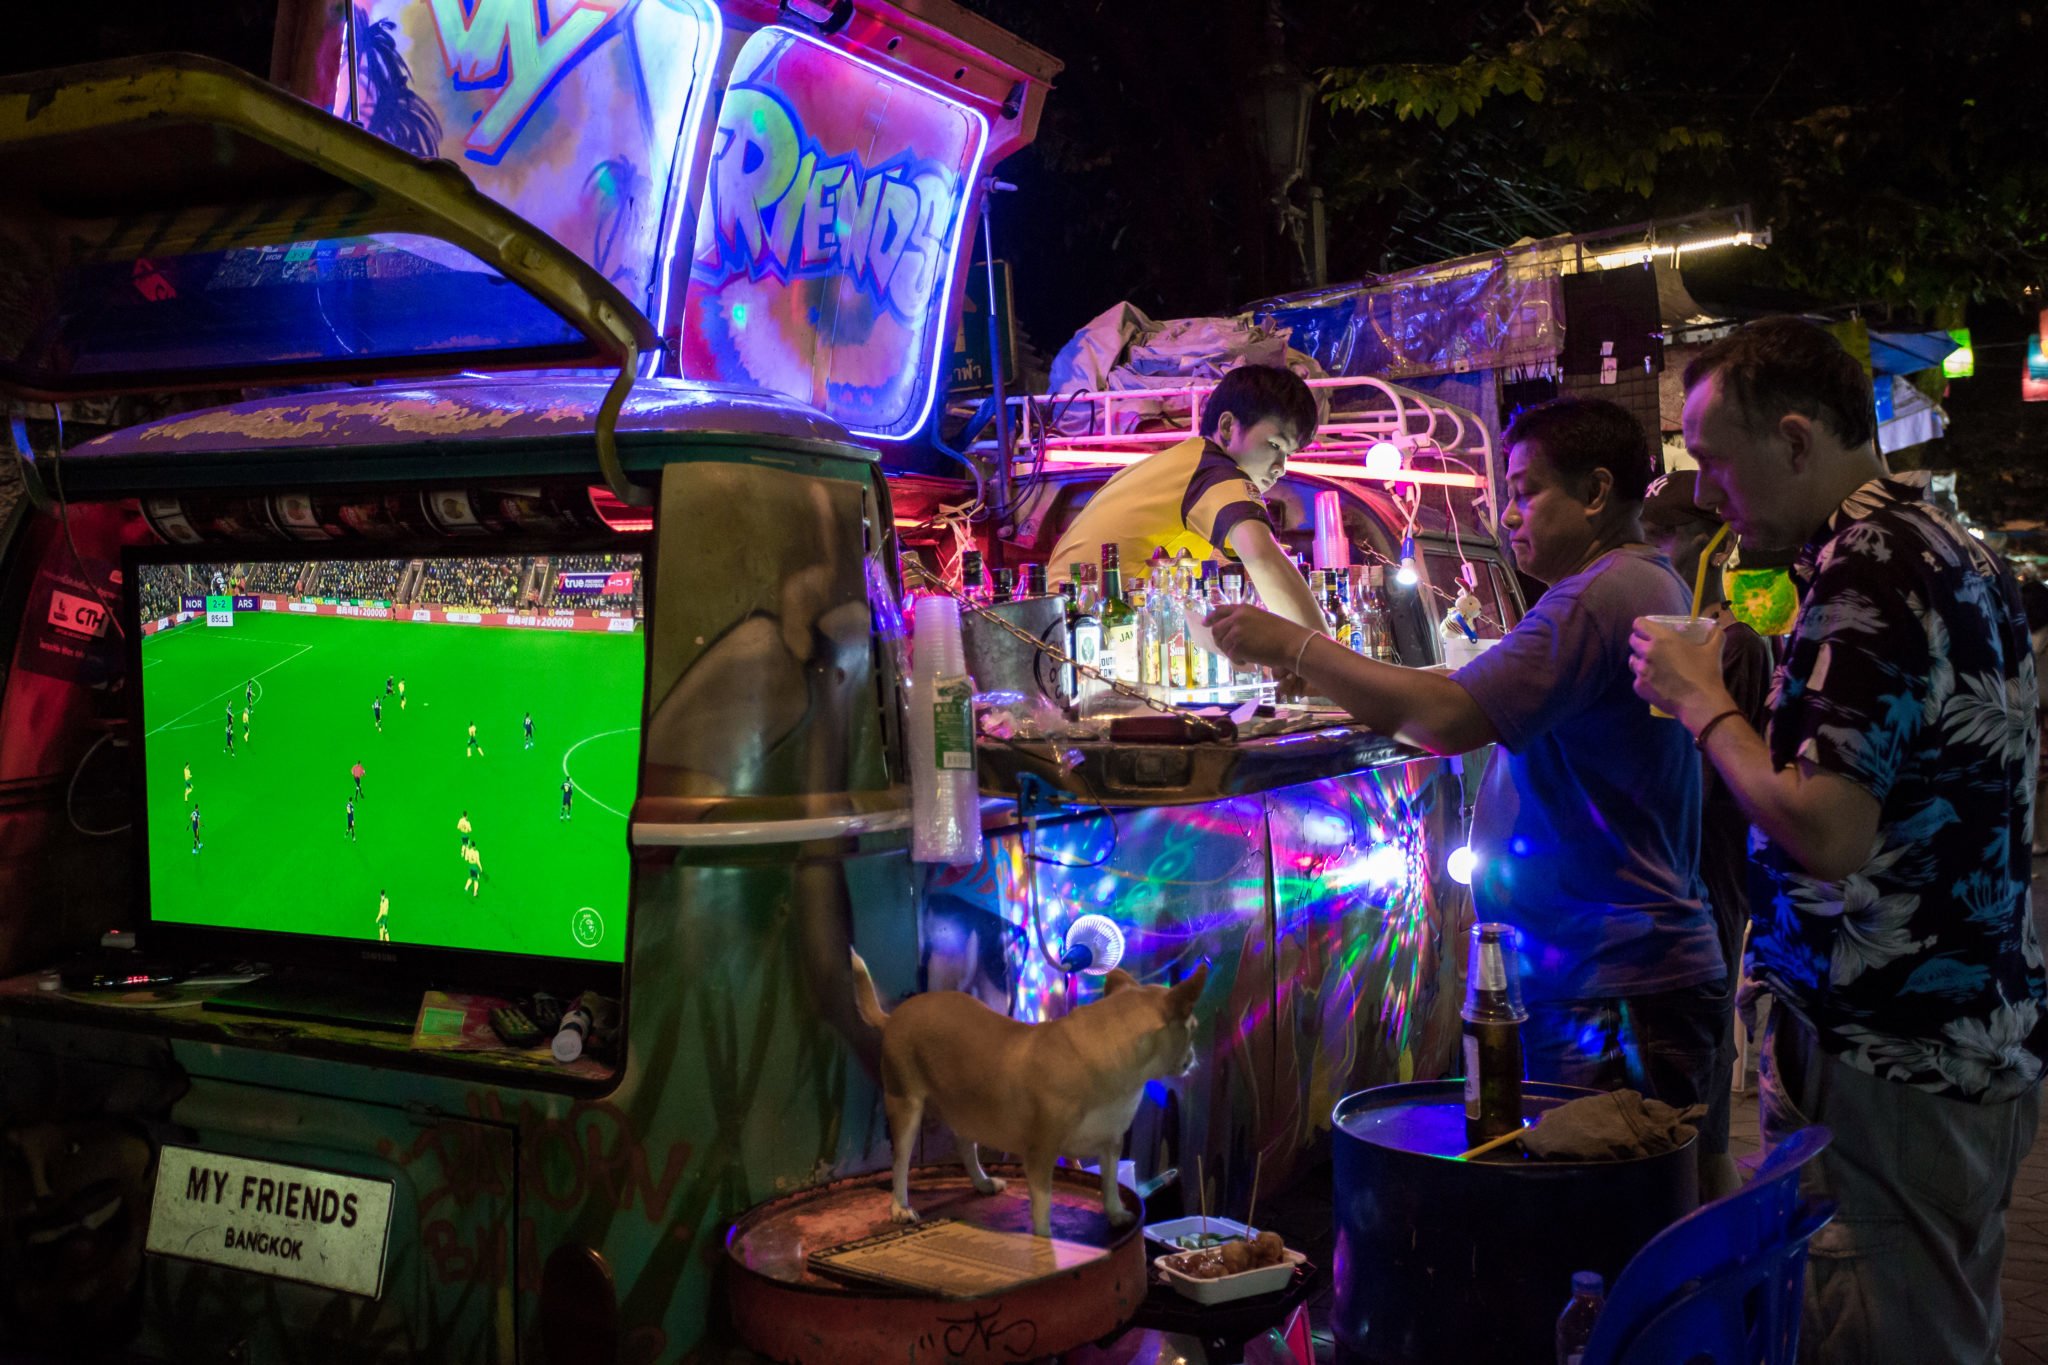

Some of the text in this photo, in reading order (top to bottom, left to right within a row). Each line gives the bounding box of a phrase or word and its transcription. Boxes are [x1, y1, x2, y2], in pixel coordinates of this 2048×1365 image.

[565, 577, 584, 588] true
[185, 599, 203, 609] NOR
[212, 599, 226, 608] 2-2
[237, 599, 253, 608] ARS
[585, 598, 606, 606] LIVE
[75, 606, 106, 631] CTH
[211, 614, 229, 623] 85:11
[186, 1166, 358, 1228] MY FRIENDS
[224, 1227, 304, 1261] BANGKOK
